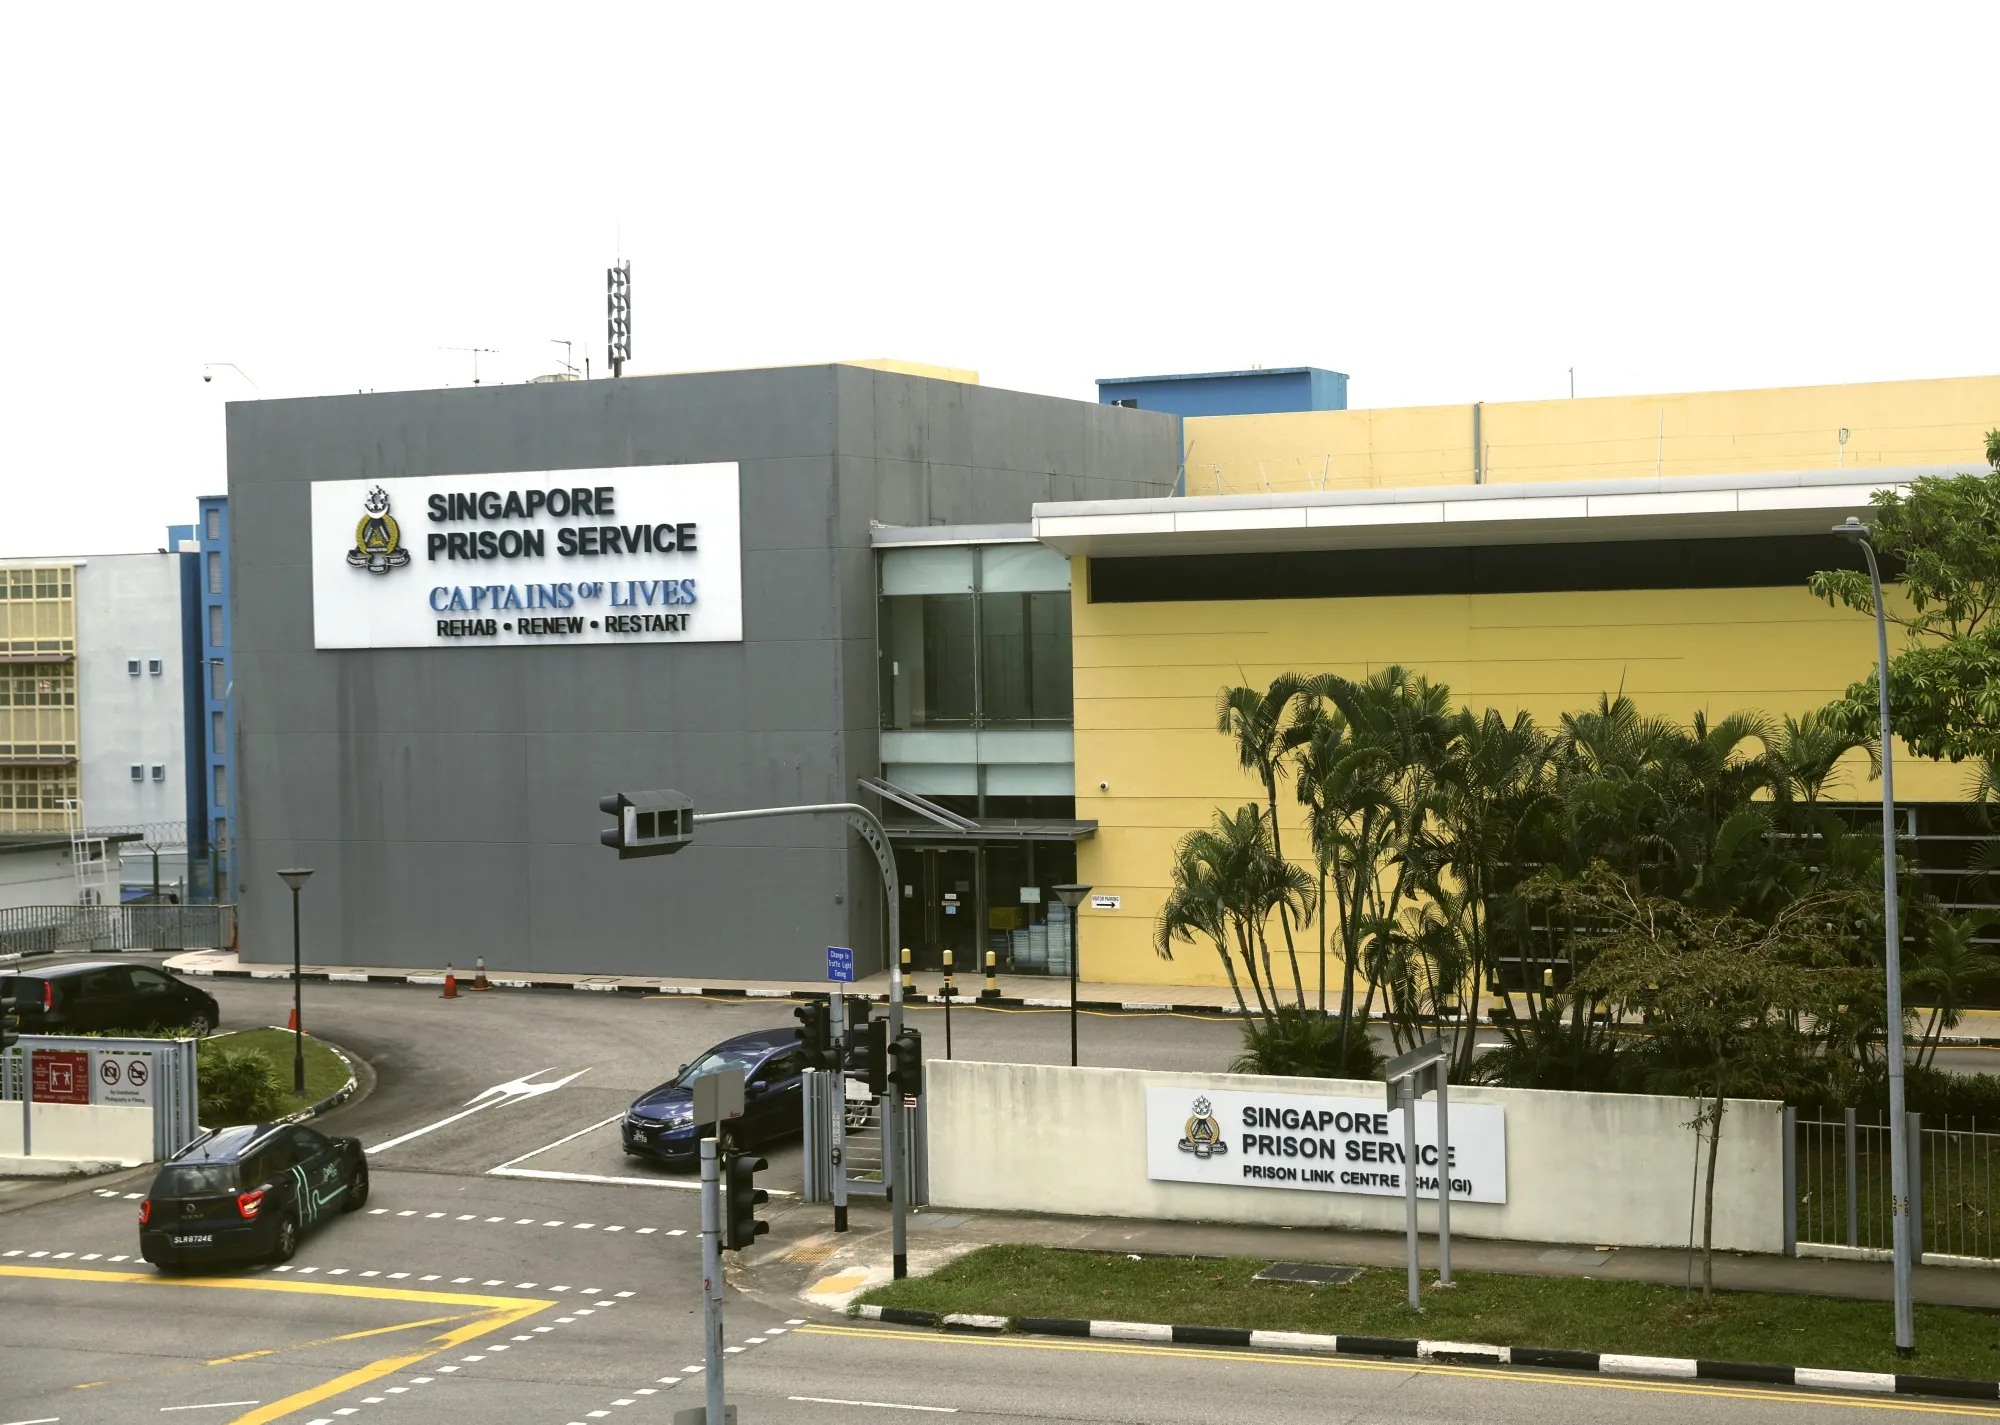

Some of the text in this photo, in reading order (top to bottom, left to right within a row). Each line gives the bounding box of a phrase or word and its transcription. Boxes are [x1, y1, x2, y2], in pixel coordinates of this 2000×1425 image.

[427, 486, 616, 524] SINGAPORE
[427, 528, 545, 562] PRISON
[556, 522, 698, 558] SERVICE
[429, 578, 698, 613] CAPTAINS OF LIVES
[436, 613, 691, 639] REHAB RENEW RESTART
[828, 959, 841, 968] Traffic
[1242, 1106, 1389, 1136] SINGAPORE
[1242, 1133, 1336, 1160] PRISON
[1243, 1164, 1473, 1196] PRISON LINK CENTRE HAGI)
